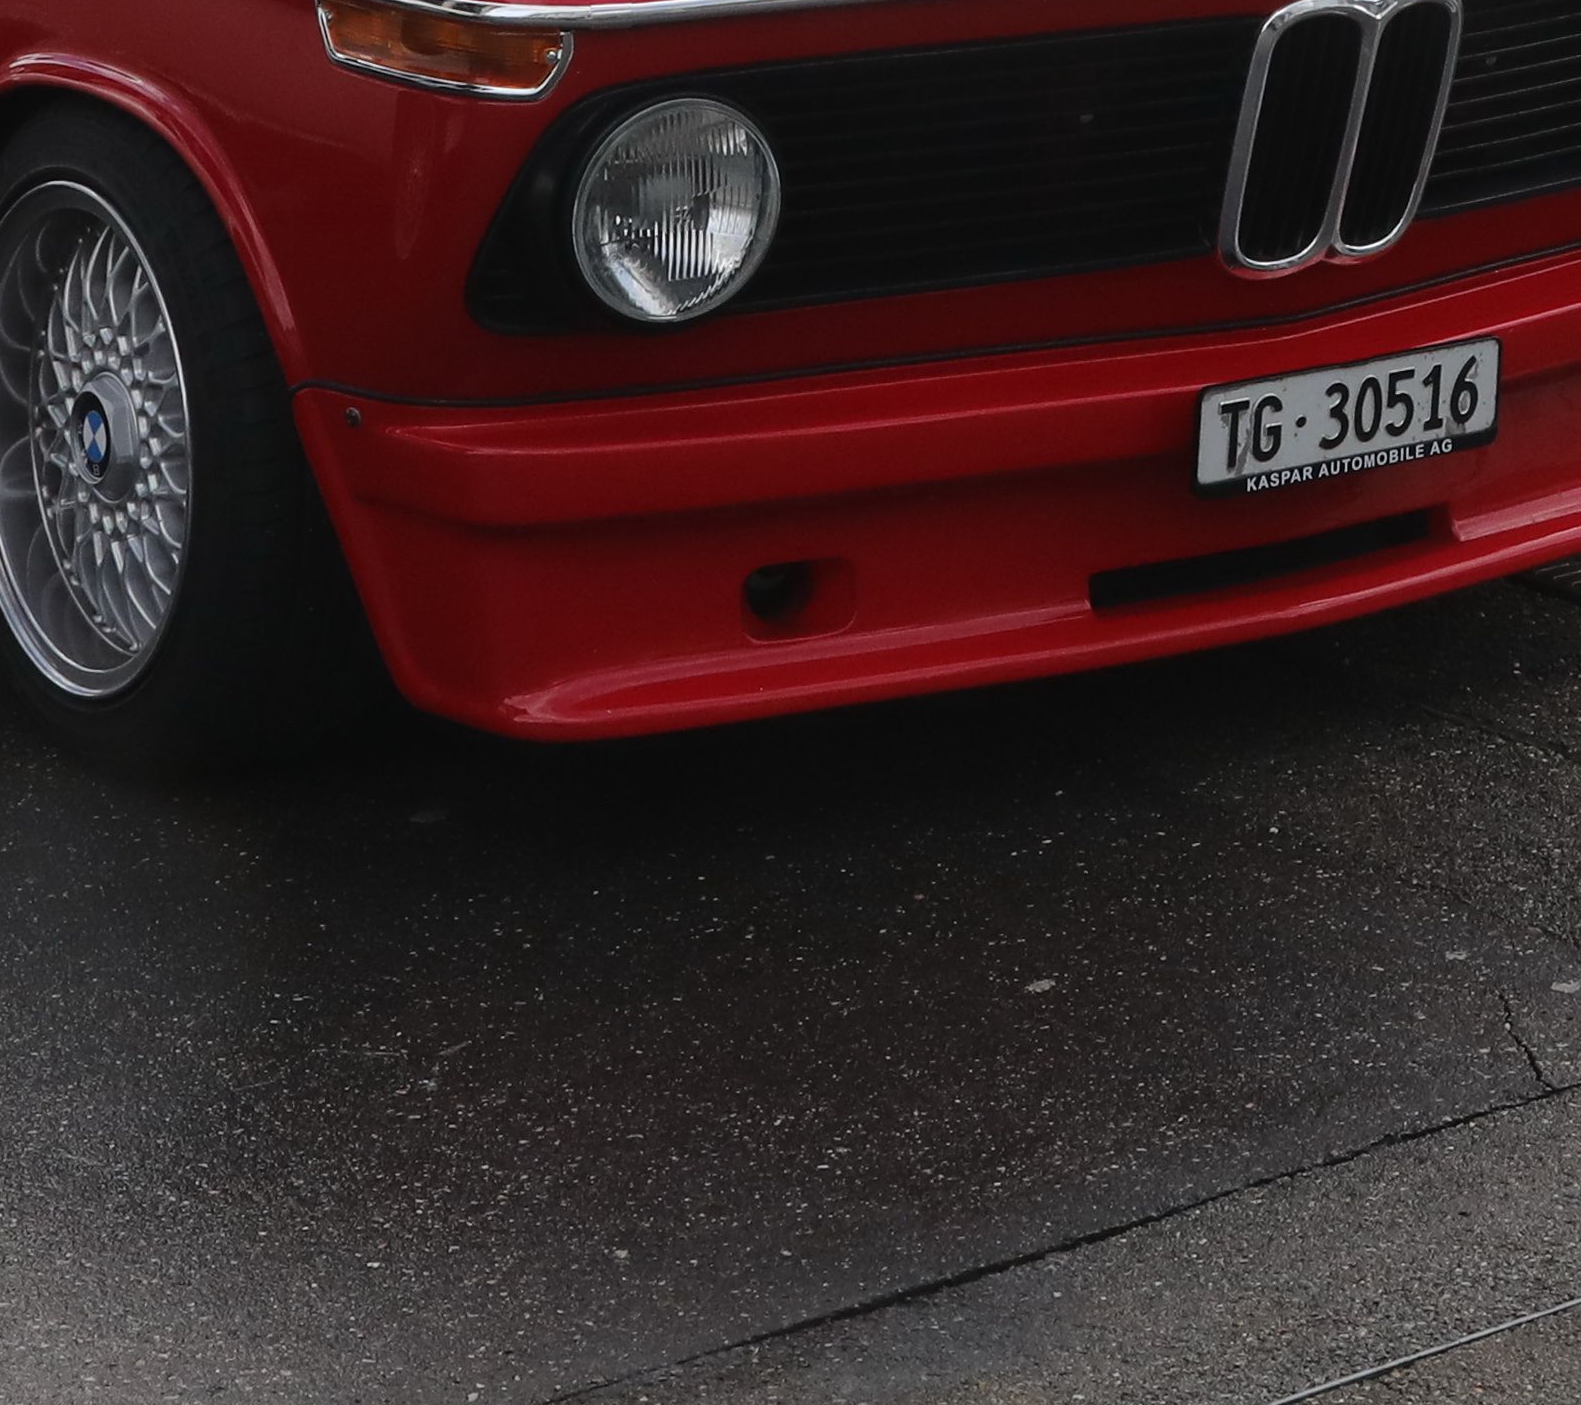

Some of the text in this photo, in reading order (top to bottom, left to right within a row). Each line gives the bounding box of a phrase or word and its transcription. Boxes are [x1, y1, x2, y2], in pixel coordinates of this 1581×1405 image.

[1246, 438, 1454, 492] KASPAR AUTOMOBILE AG
